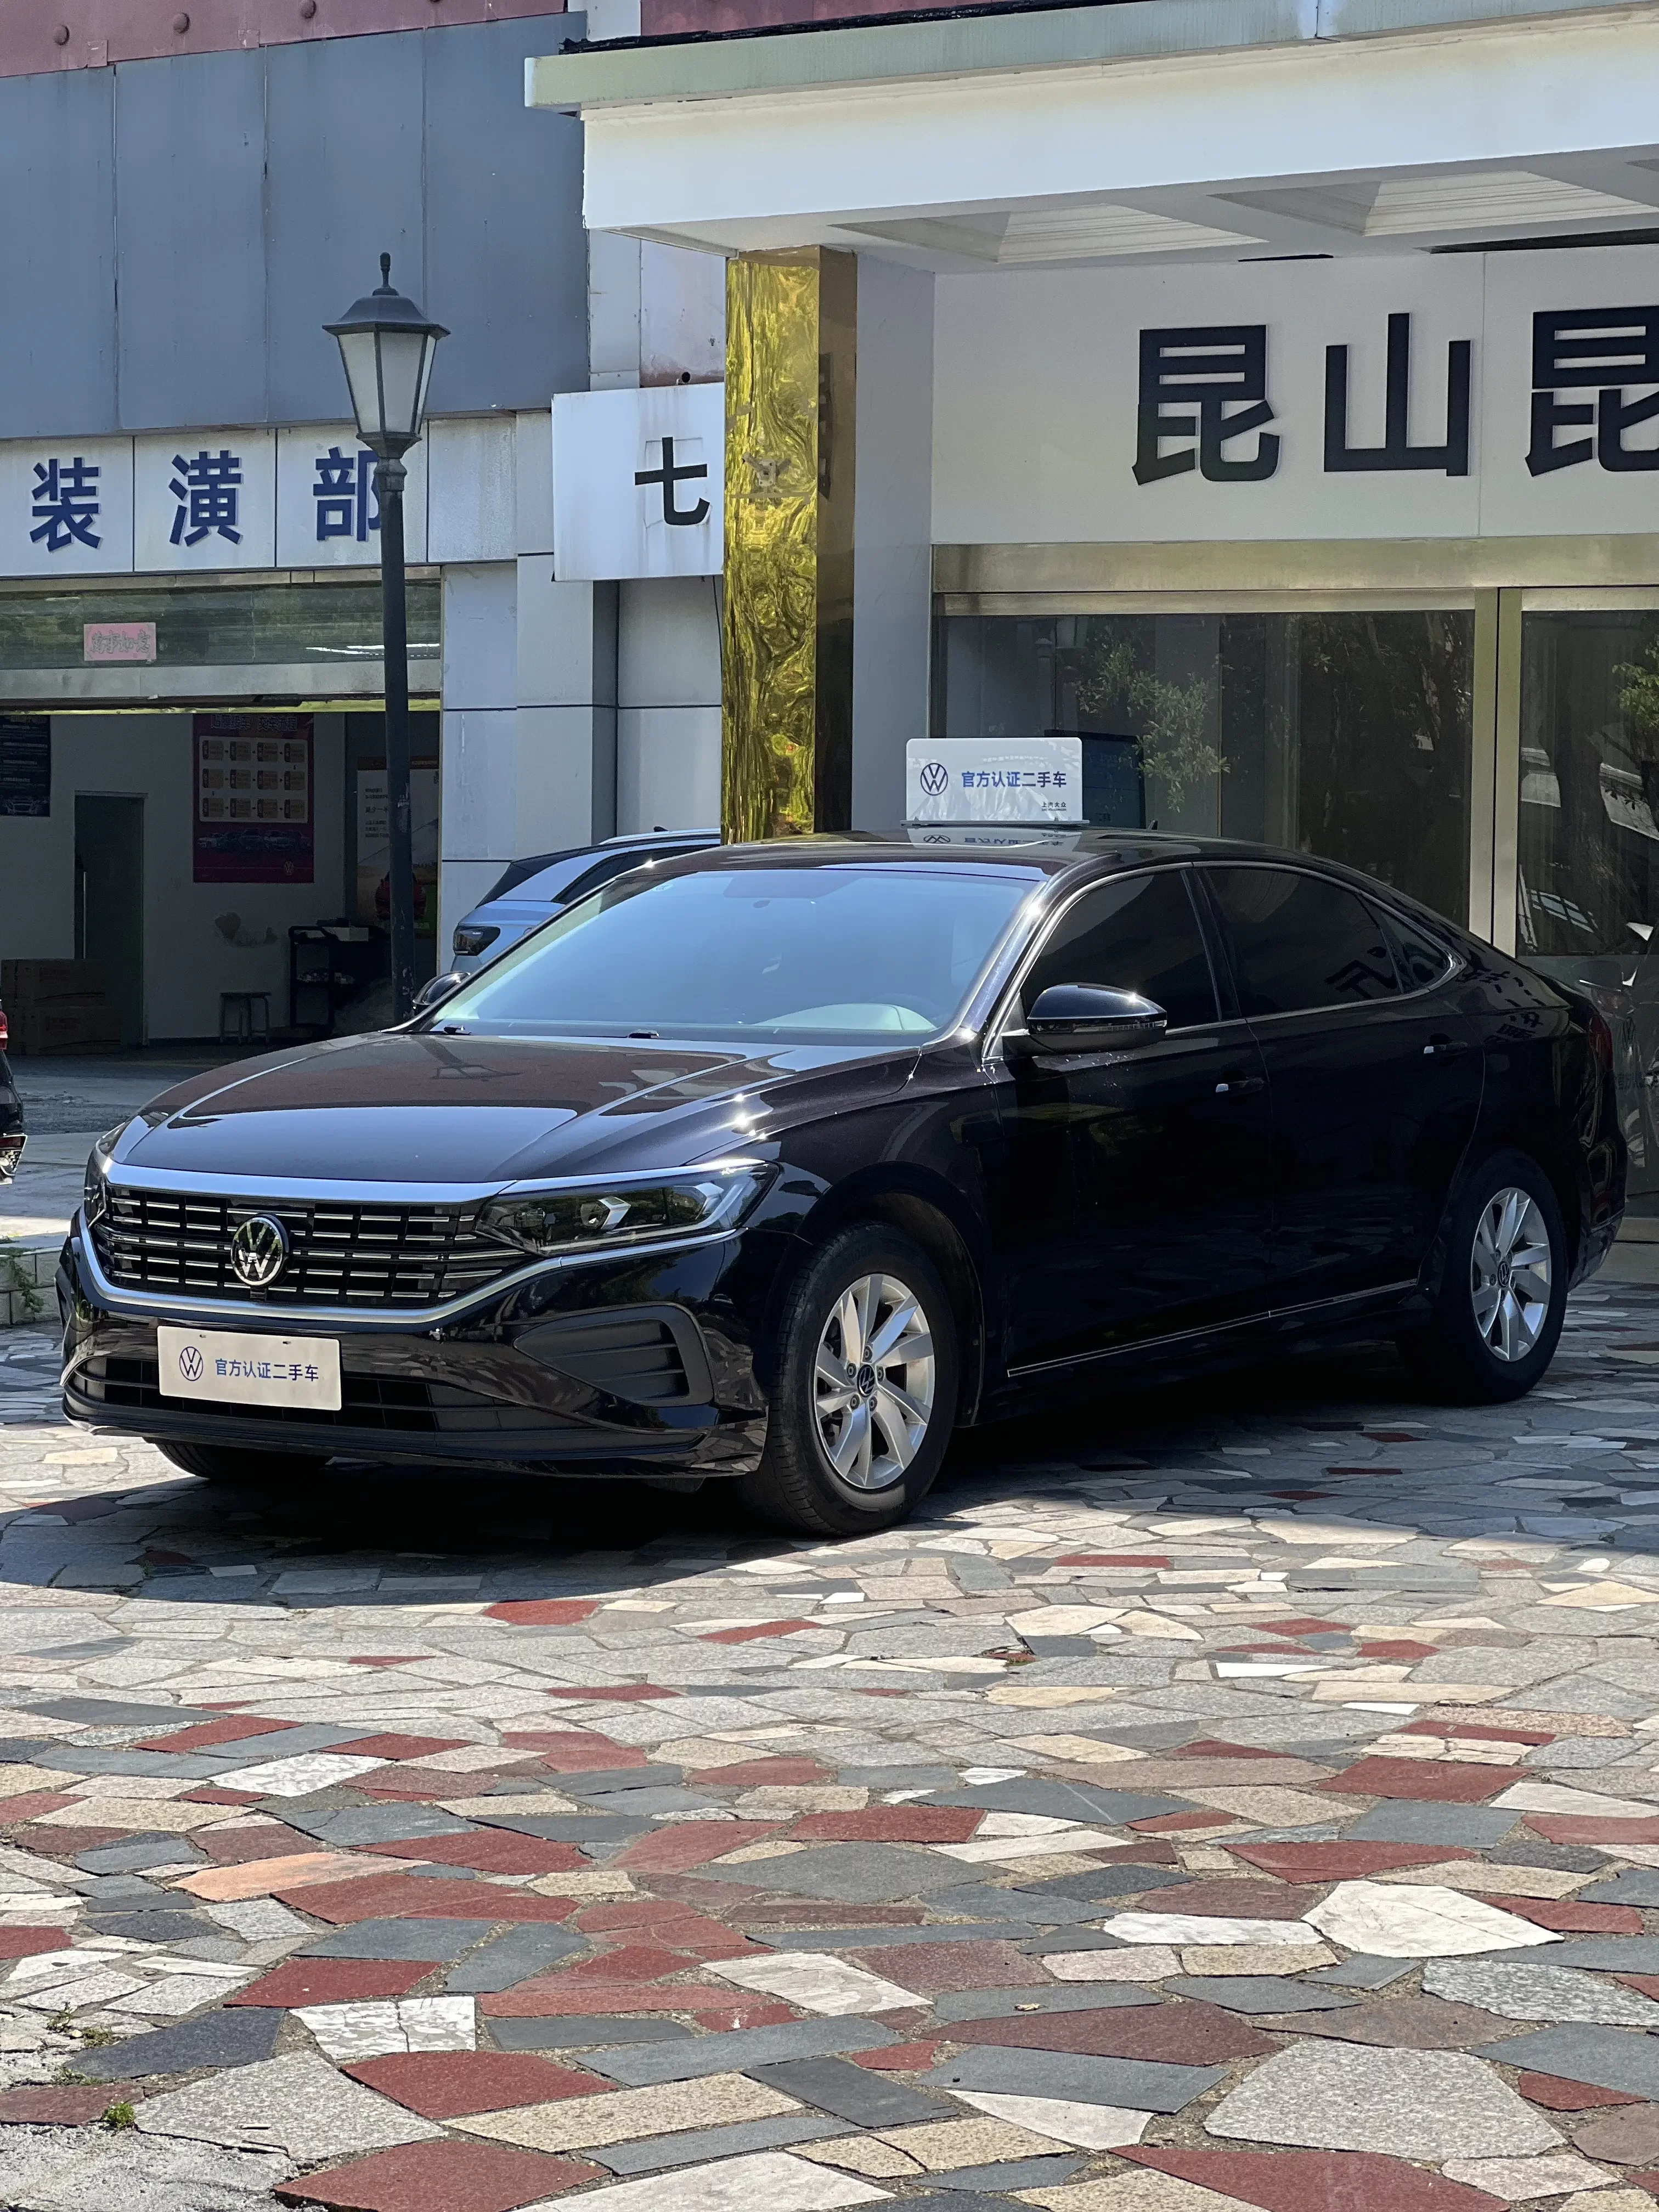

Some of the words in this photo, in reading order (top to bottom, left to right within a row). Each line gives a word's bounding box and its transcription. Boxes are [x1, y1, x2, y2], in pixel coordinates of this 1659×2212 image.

[1132, 305, 1659, 486] 昆山昆
[30, 447, 380, 551] 装潢部
[635, 437, 710, 526] 七
[961, 771, 1067, 788] 官方认证二手车
[215, 1358, 319, 1382] 官方认证二手车
